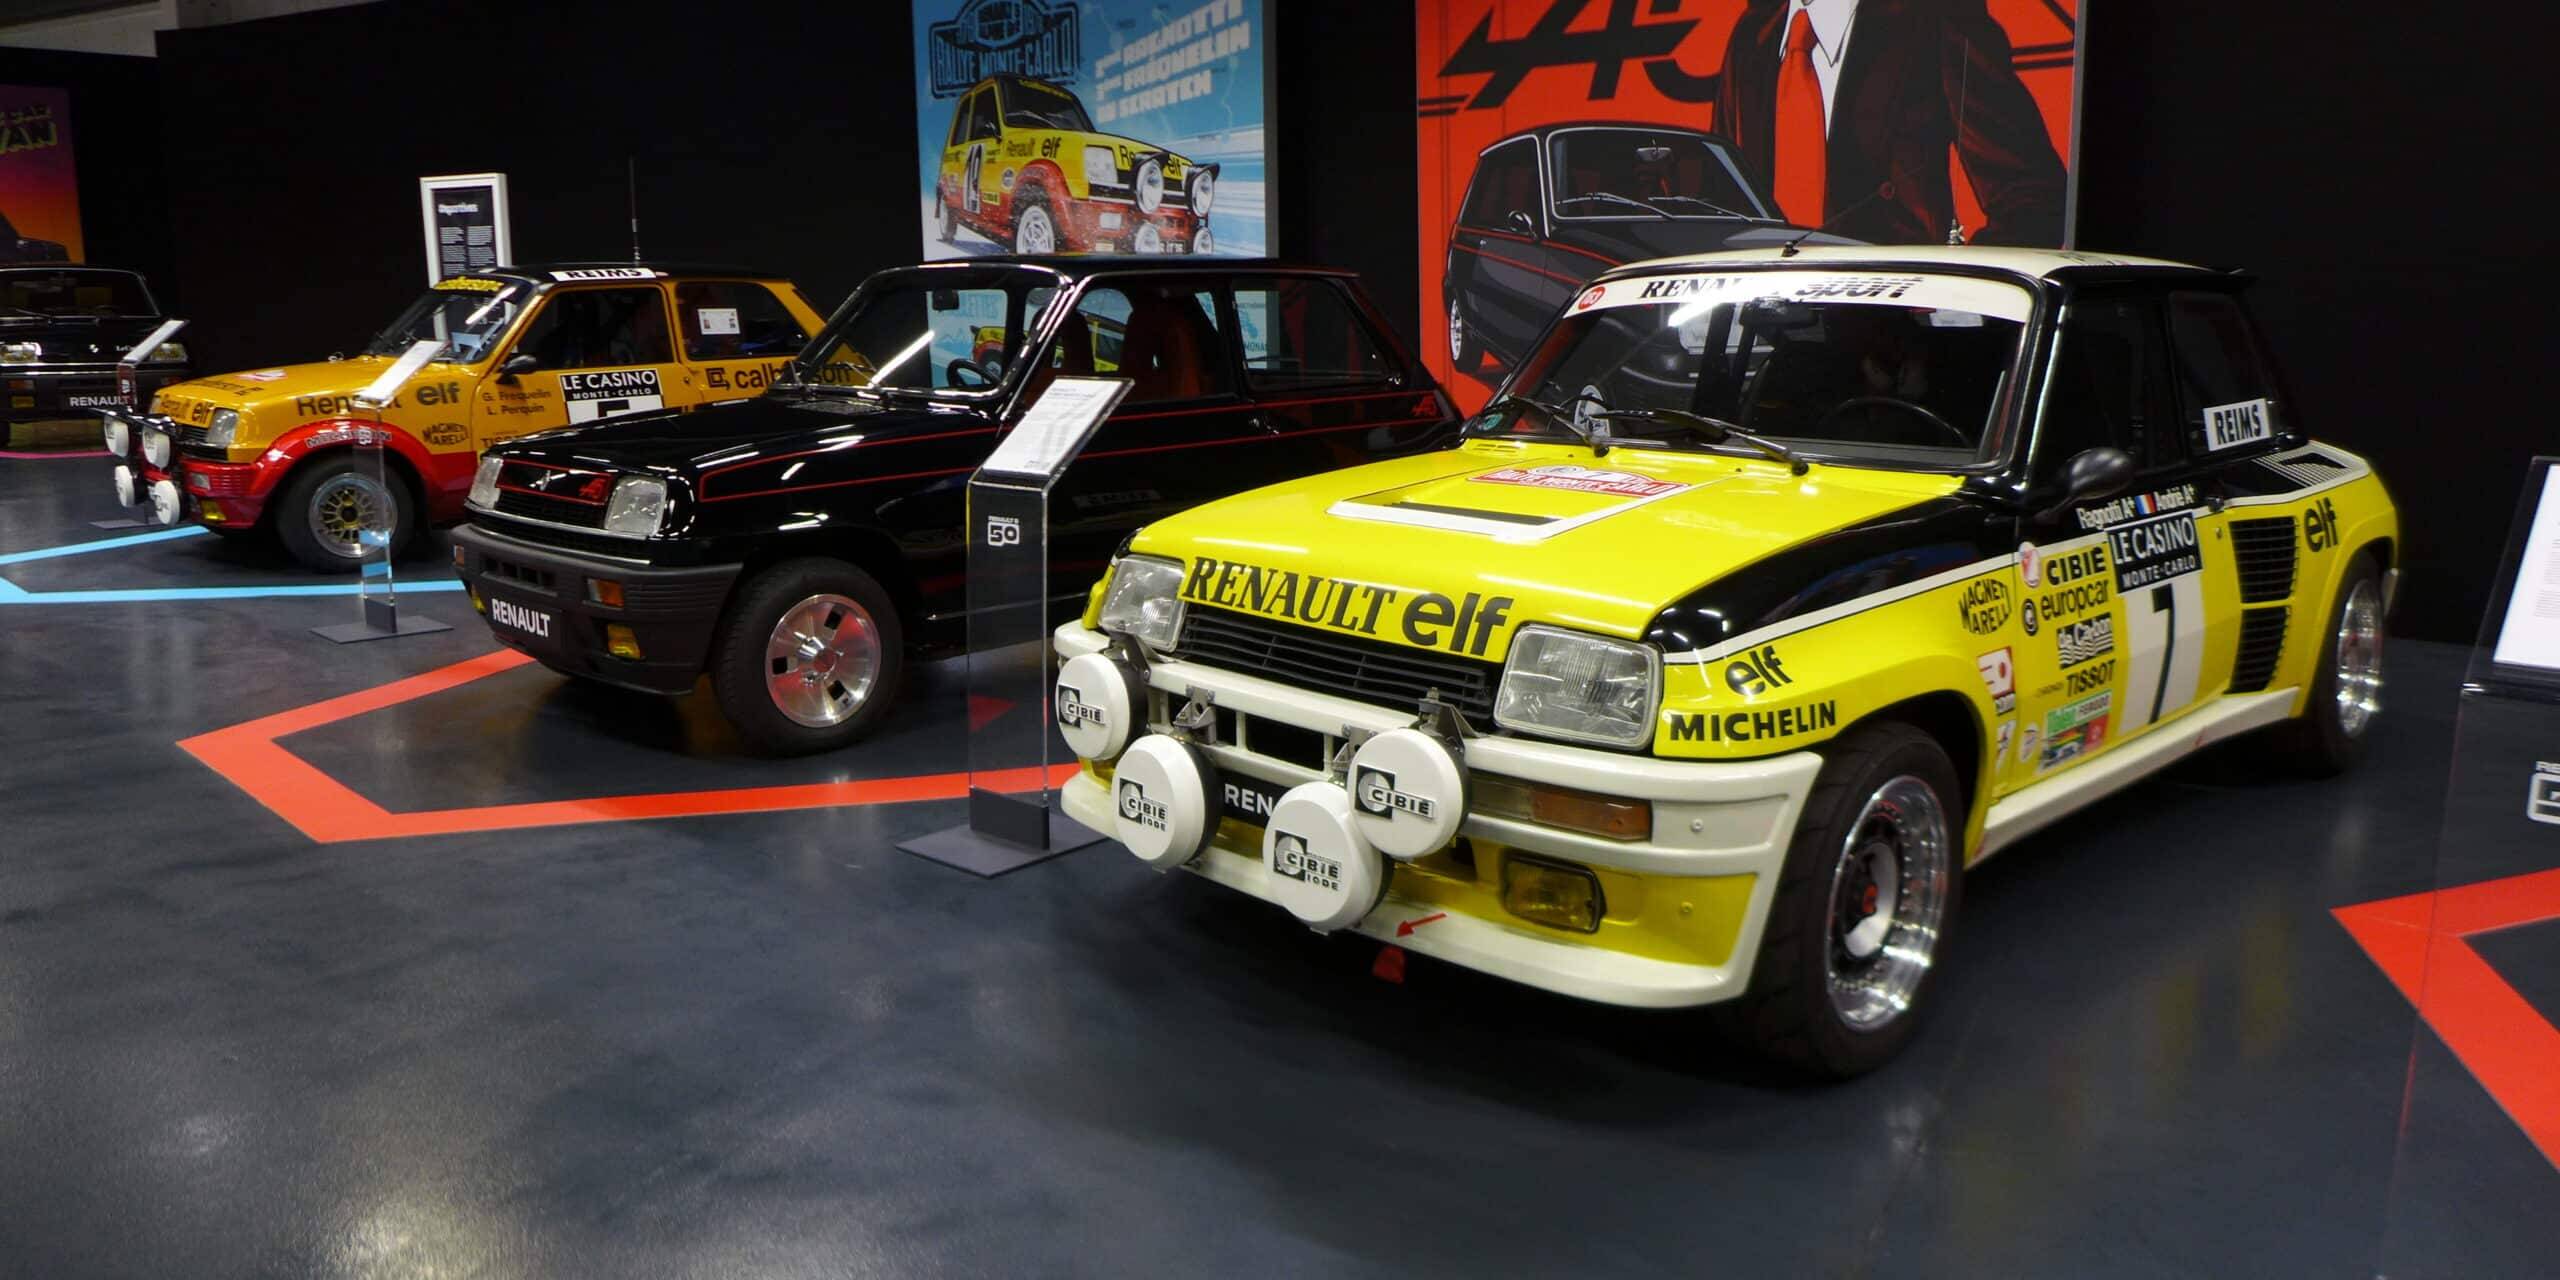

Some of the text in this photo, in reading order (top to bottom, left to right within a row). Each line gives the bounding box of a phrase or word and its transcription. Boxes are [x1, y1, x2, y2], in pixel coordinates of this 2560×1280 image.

[1041, 136, 1061, 159] elf
[564, 269, 643, 279] REIMS
[416, 382, 460, 405] elf
[562, 371, 656, 390] LE CASINO
[69, 395, 130, 407] RENAULT
[2213, 403, 2261, 446] REIMS
[988, 521, 1020, 546] 50
[2110, 516, 2196, 565] LE CASINO
[2304, 497, 2339, 553] elf
[492, 598, 551, 637] RENAULT
[1181, 556, 1515, 657] RENAULT elf
[2041, 579, 2111, 620] europcar
[1724, 644, 1793, 698] elf
[2148, 583, 2177, 725] 7
[2066, 658, 2116, 698] TISSOT
[1669, 700, 1837, 742] MICHELIN
